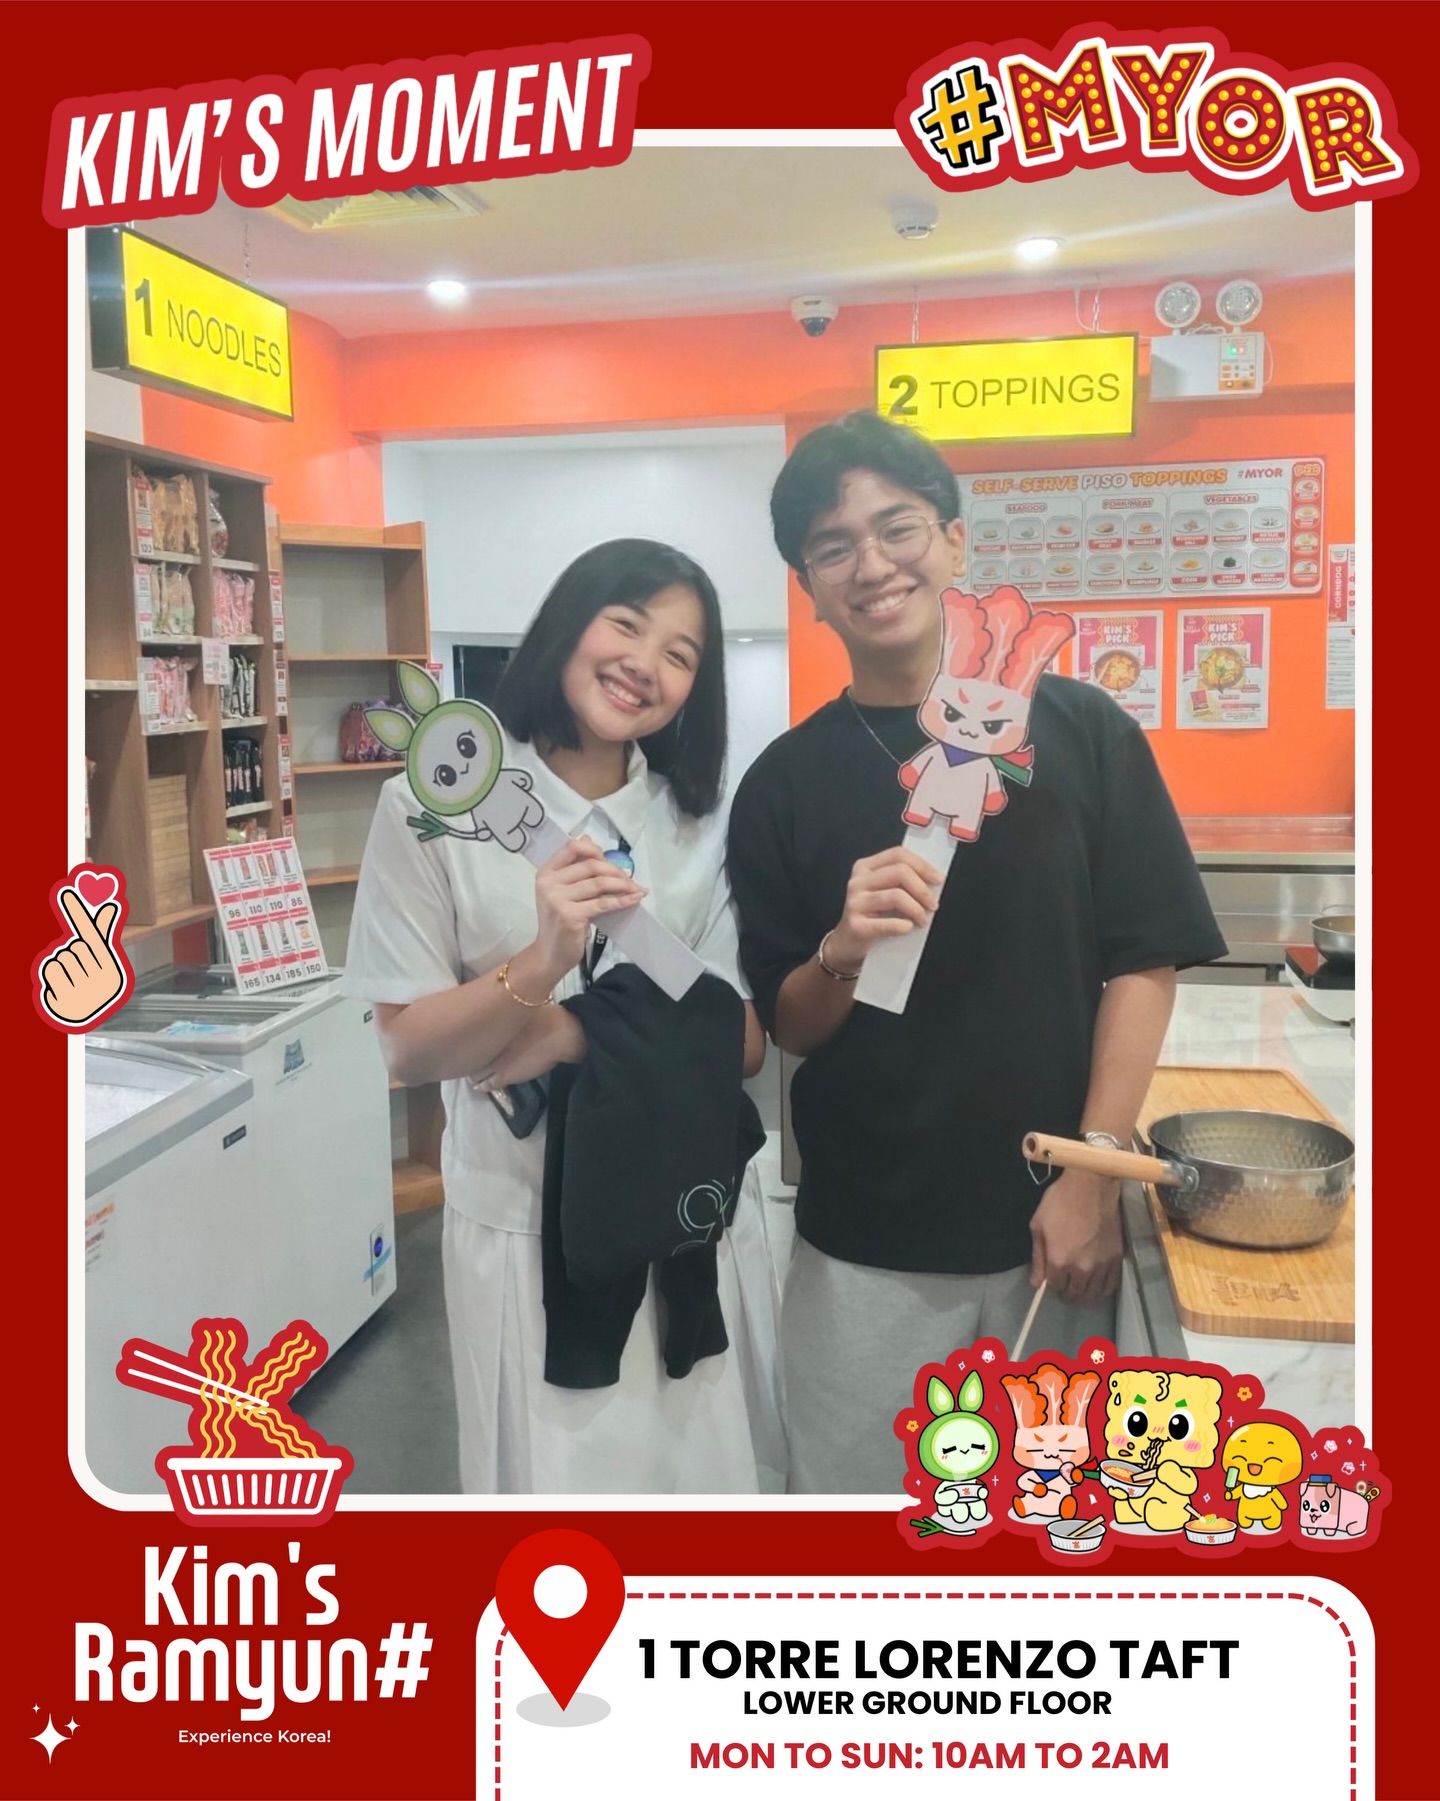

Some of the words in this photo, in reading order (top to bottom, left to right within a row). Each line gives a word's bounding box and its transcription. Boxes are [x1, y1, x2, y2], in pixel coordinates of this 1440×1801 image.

[134, 277, 153, 338] 1
[167, 298, 282, 377] NOODLES
[888, 374, 918, 417] 2
[929, 372, 1120, 409] TOPPINGS
[1237, 467, 1284, 480] #MYOR
[971, 475, 1080, 496] SELF-SERVE
[1081, 473, 1128, 490] PISO
[1129, 467, 1228, 487] TOPPINGS
[1205, 494, 1258, 505] VEGETABLES
[1006, 503, 1047, 514] SEAFOOD
[1334, 565, 1342, 609] CORNDOG
[1105, 634, 1130, 644] PICK
[1210, 632, 1236, 642] PICK
[249, 904, 263, 914] 110
[269, 900, 283, 910] 110
[228, 908, 241, 919] 96
[286, 968, 302, 979] 185
[305, 964, 321, 974] 150
[244, 977, 260, 989] 165
[265, 973, 281, 984] 134
